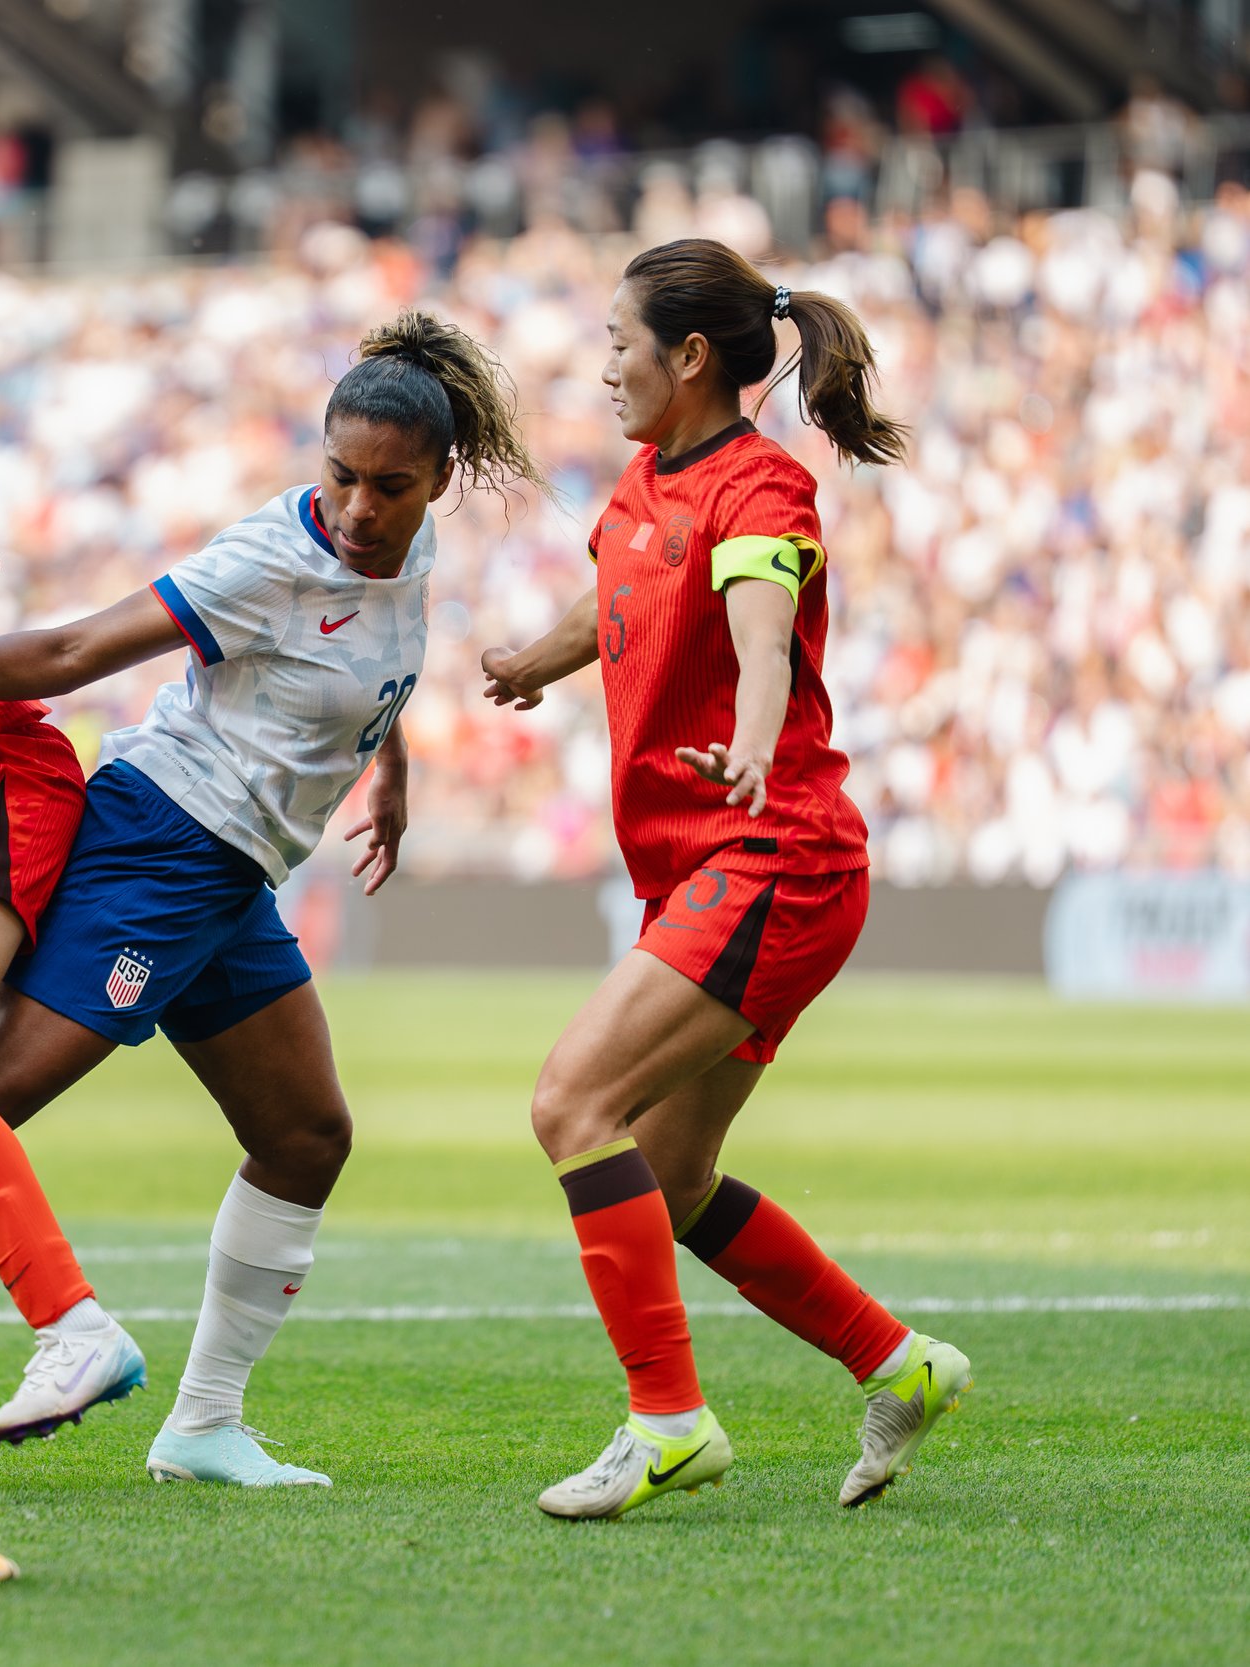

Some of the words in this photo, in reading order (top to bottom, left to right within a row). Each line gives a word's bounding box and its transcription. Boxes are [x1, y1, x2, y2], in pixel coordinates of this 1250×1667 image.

[606, 585, 632, 664] 5
[355, 673, 417, 753] 20
[117, 958, 147, 983] USA
